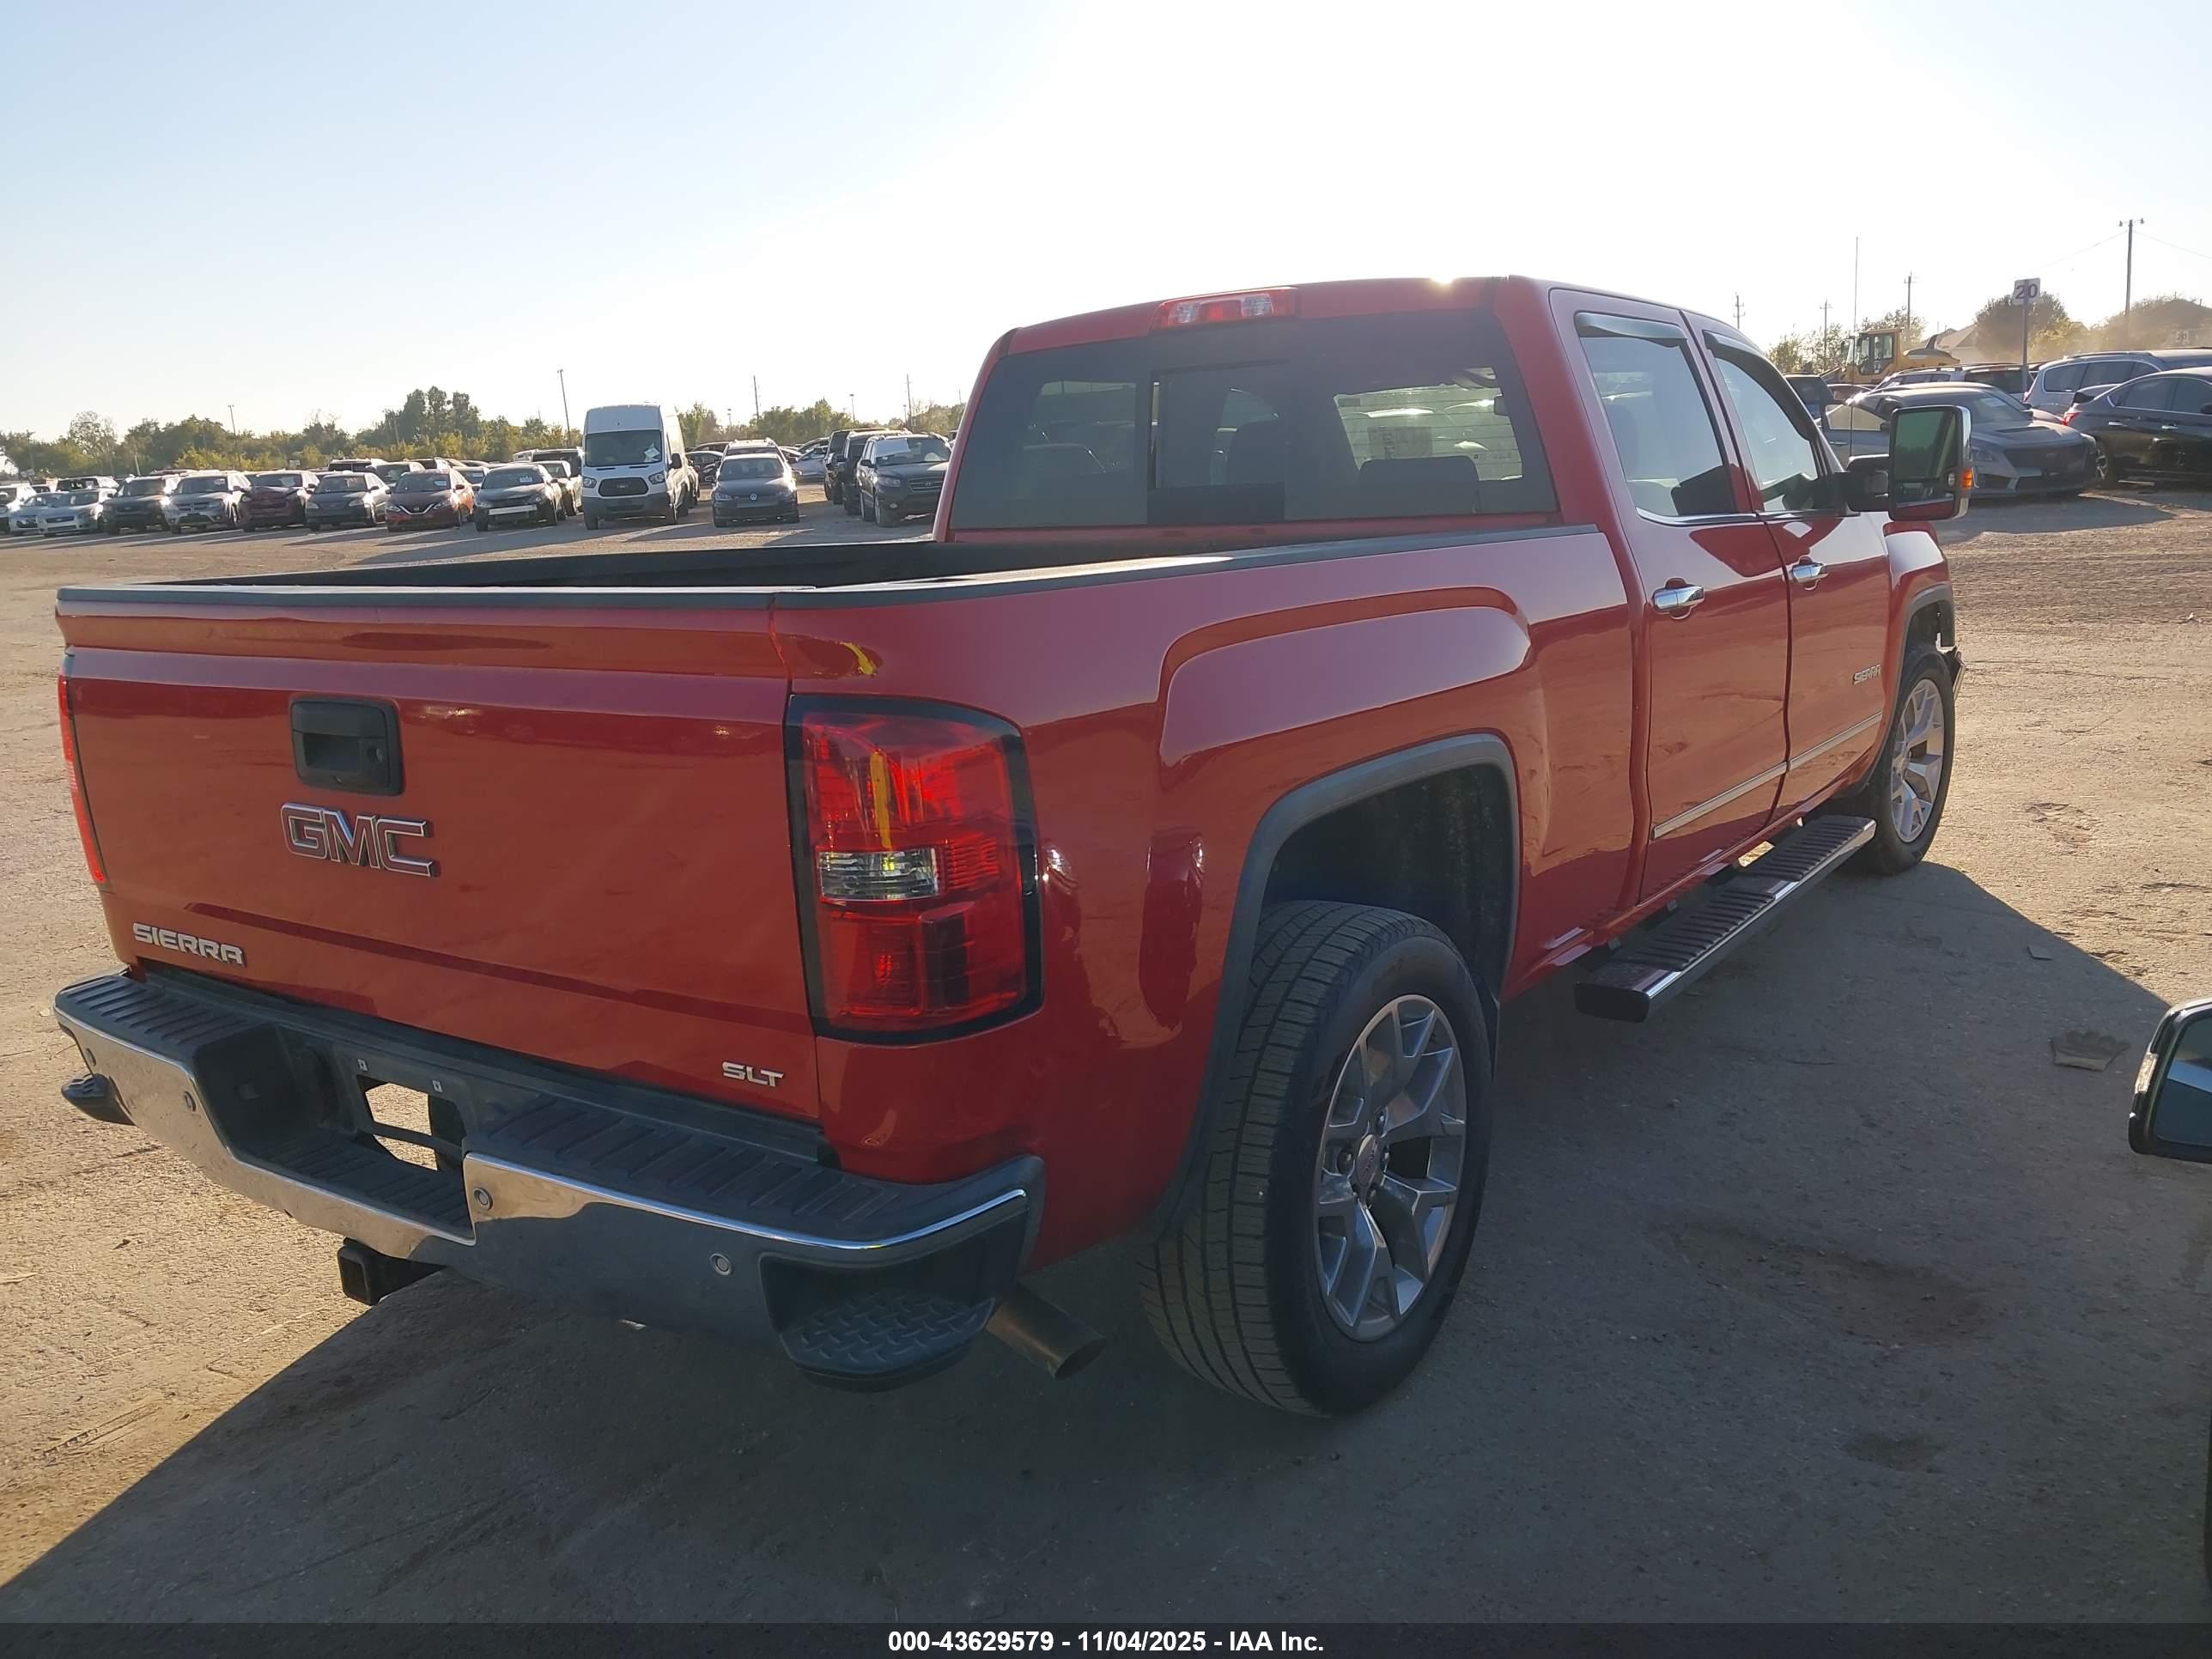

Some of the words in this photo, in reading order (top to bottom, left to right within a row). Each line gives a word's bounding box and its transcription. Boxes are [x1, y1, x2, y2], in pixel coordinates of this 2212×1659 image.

[2015, 283, 2039, 299] 20
[281, 802, 438, 878] GMC
[132, 922, 246, 968] SIERRA
[722, 1061, 785, 1087] SLT
